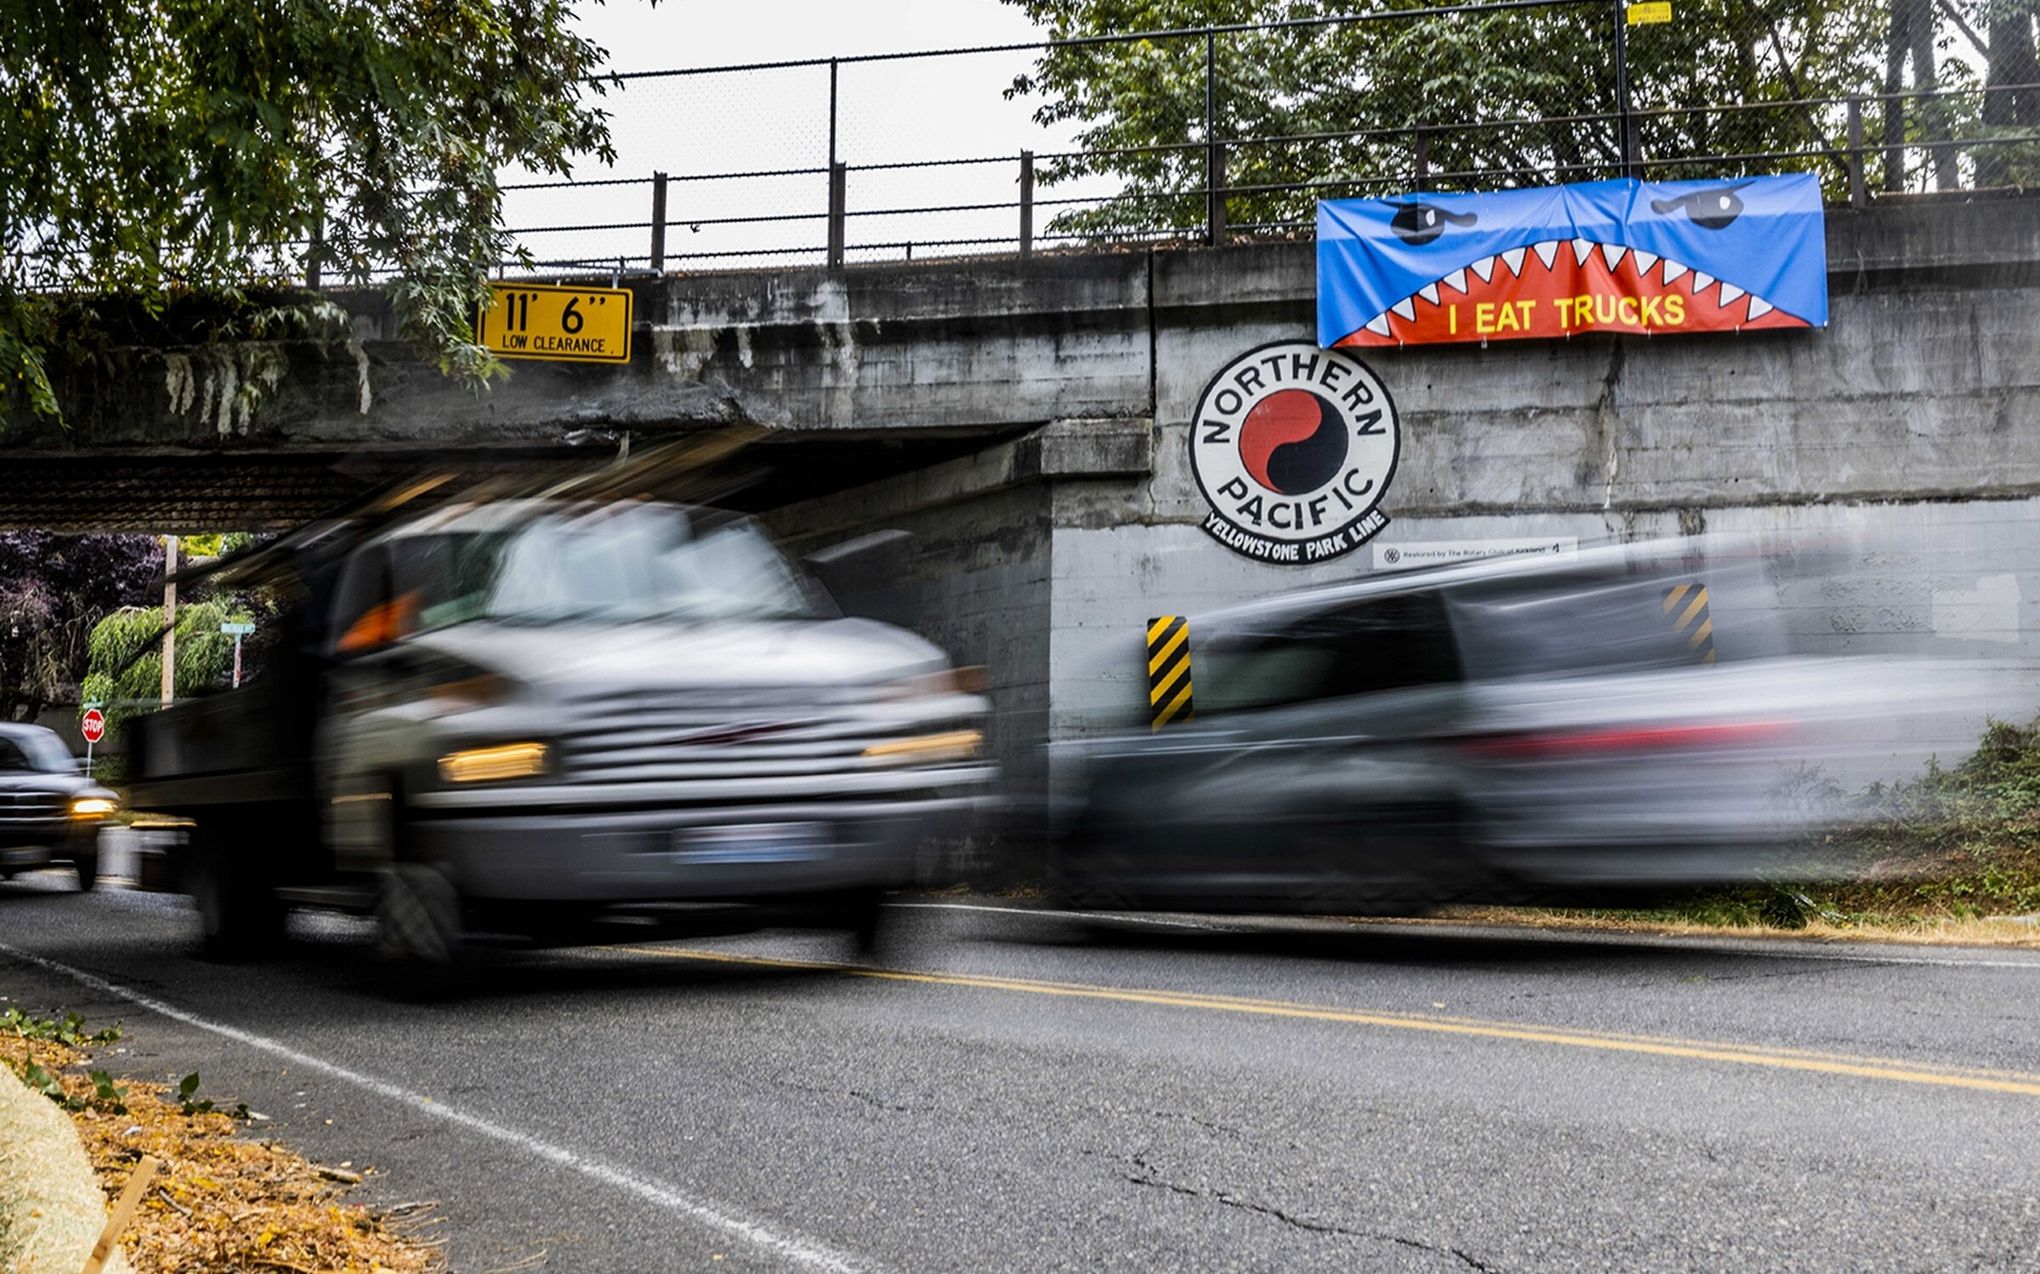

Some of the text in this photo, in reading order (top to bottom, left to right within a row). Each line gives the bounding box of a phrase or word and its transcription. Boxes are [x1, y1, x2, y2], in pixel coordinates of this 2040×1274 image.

[1449, 294, 1686, 334] I EAT TRUCKS
[502, 334, 605, 353] LOW CLEARANCE
[1202, 353, 1387, 444] NORTHERN
[1217, 468, 1373, 530] PACIFIC
[1205, 510, 1386, 560] YELLOWSTONE PARK LINE
[83, 719, 103, 732] STOP
